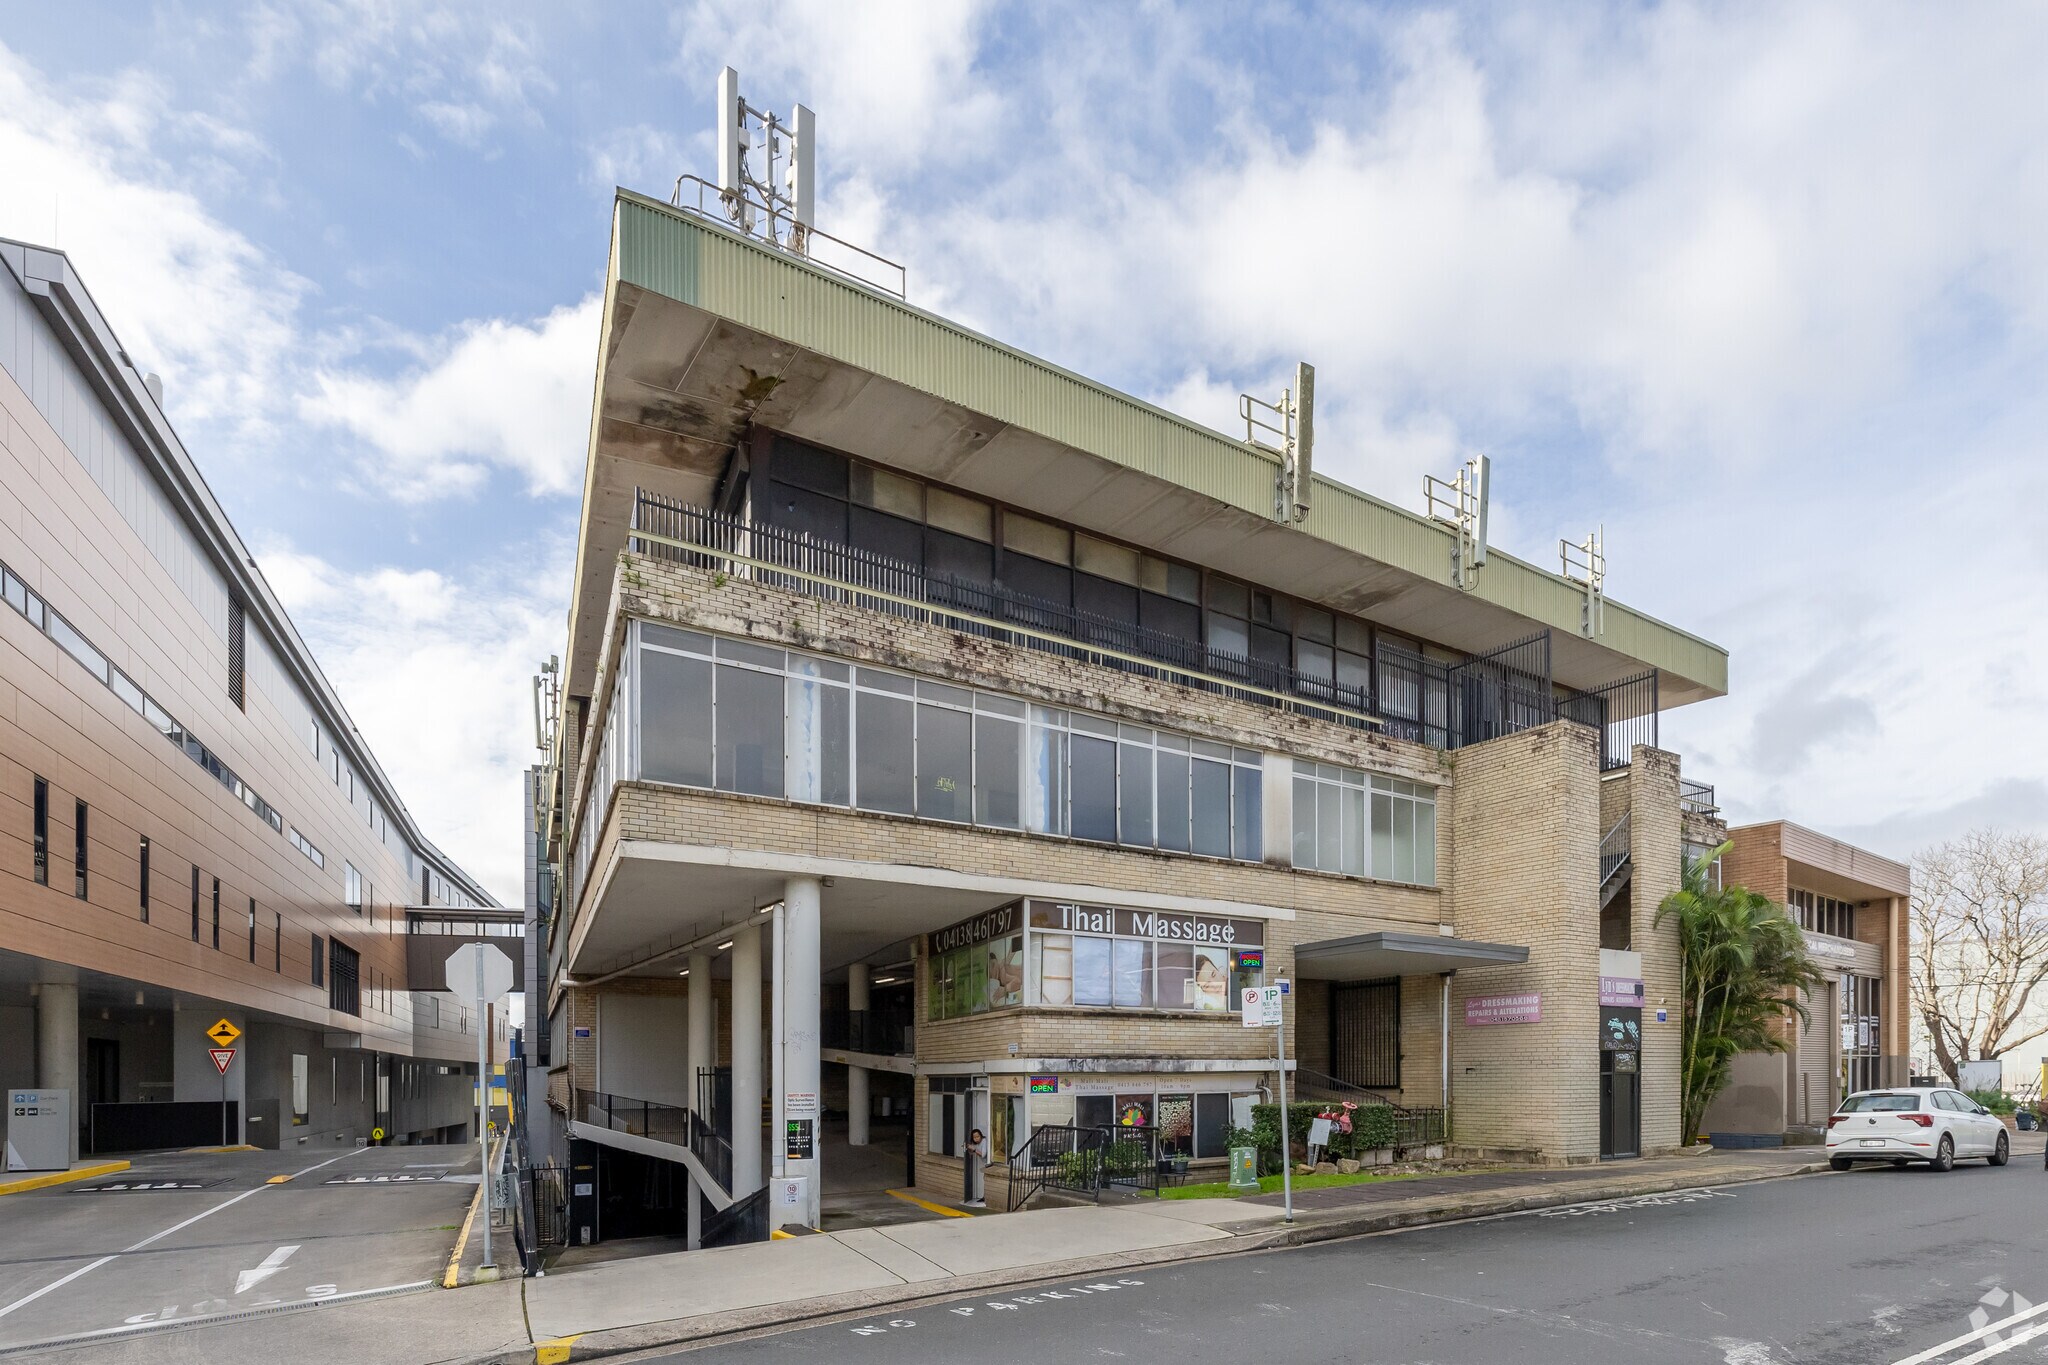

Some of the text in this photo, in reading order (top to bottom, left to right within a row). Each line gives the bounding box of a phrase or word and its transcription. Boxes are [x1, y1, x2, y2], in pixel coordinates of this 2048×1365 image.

[1056, 905, 1235, 943] Thai Massage
[1265, 990, 1278, 1000] 1P
[1482, 996, 1538, 1007] DRESSMAKING
[1468, 1009, 1492, 1017] REPAIRS
[1499, 1006, 1538, 1015] ALTERATIONS
[850, 1279, 1145, 1336] NO PARKING
